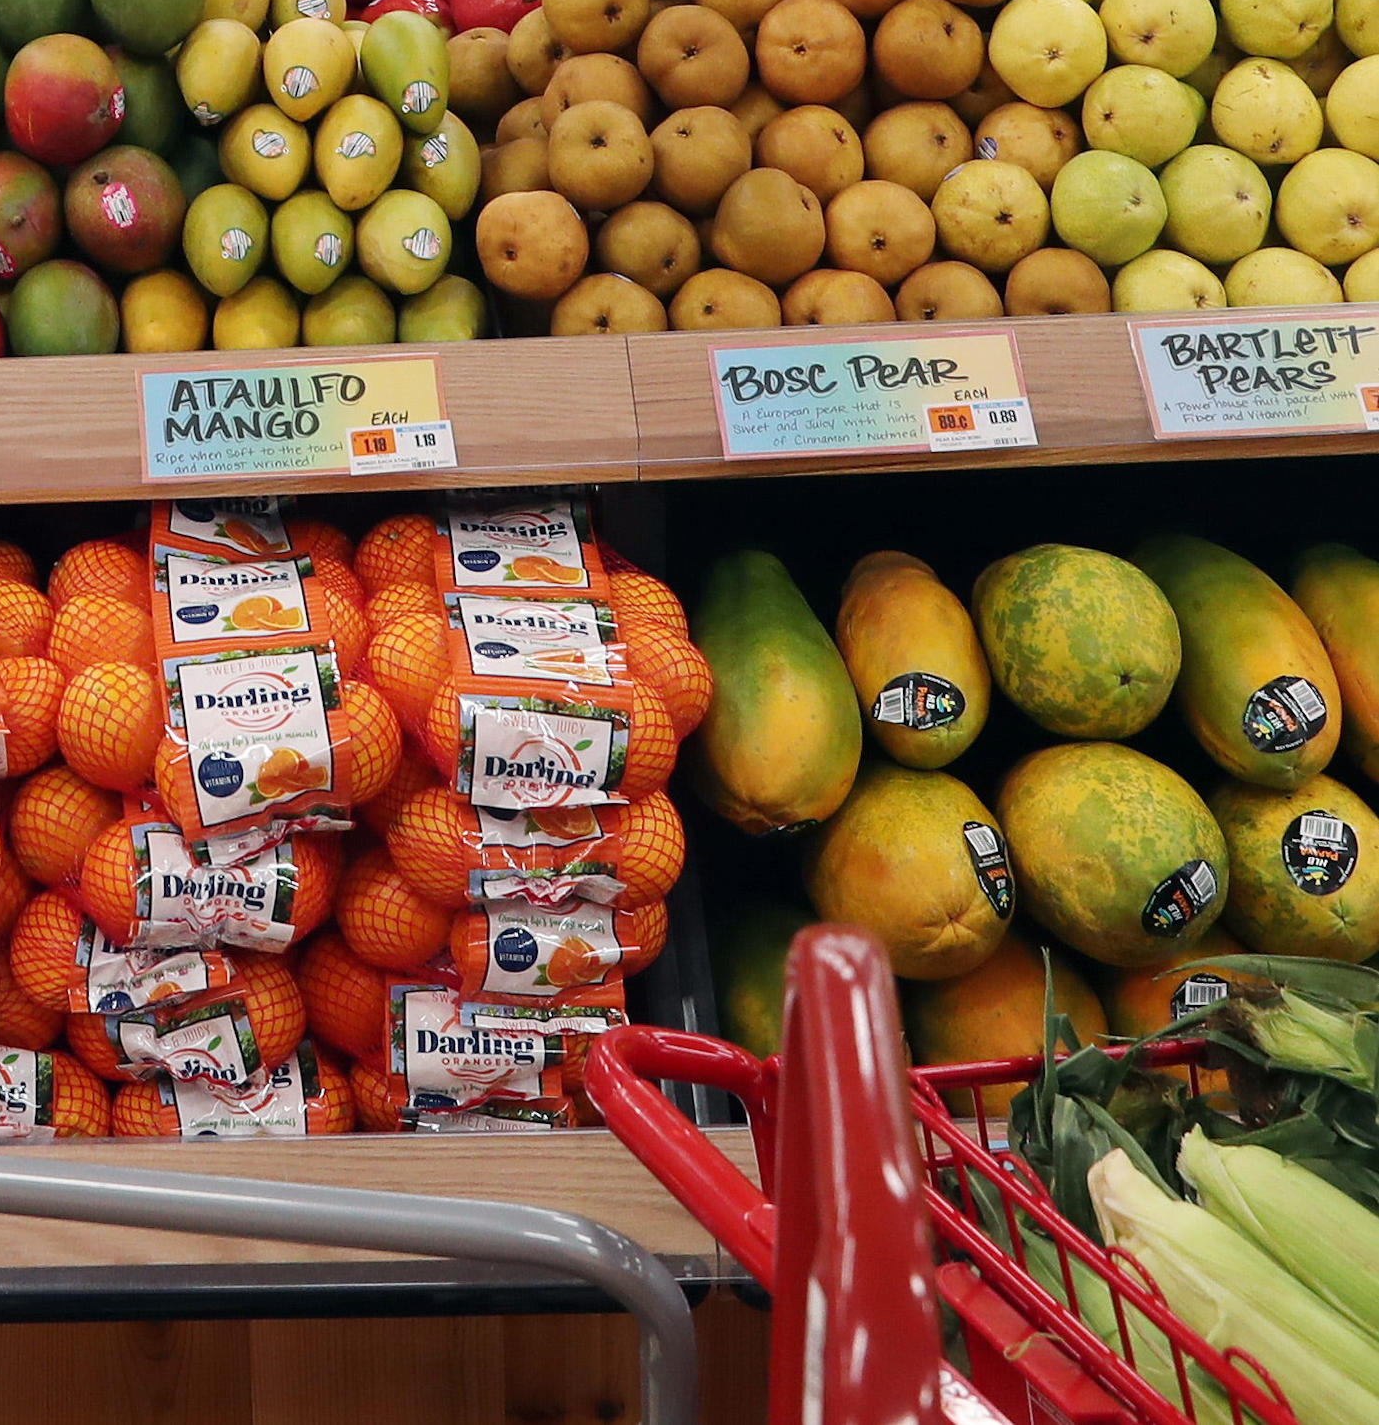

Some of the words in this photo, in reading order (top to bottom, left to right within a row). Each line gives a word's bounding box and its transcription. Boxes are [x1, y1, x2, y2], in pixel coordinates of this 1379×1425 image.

[169, 371, 367, 413] ATAULFO
[722, 364, 840, 406] BOSC
[954, 388, 989, 402] EACH
[163, 409, 321, 447] MANGO
[371, 410, 409, 426] EACH
[155, 450, 185, 465] Ripe
[190, 449, 223, 462] when
[260, 445, 275, 455] to
[278, 443, 303, 455] the
[173, 462, 200, 475] and
[180, 569, 291, 592] Darling
[190, 684, 308, 713] Darling
[484, 756, 598, 790] Darling
[160, 873, 266, 912] Darling
[415, 1028, 536, 1066] Darling
[441, 1056, 511, 1067] ORANGES
